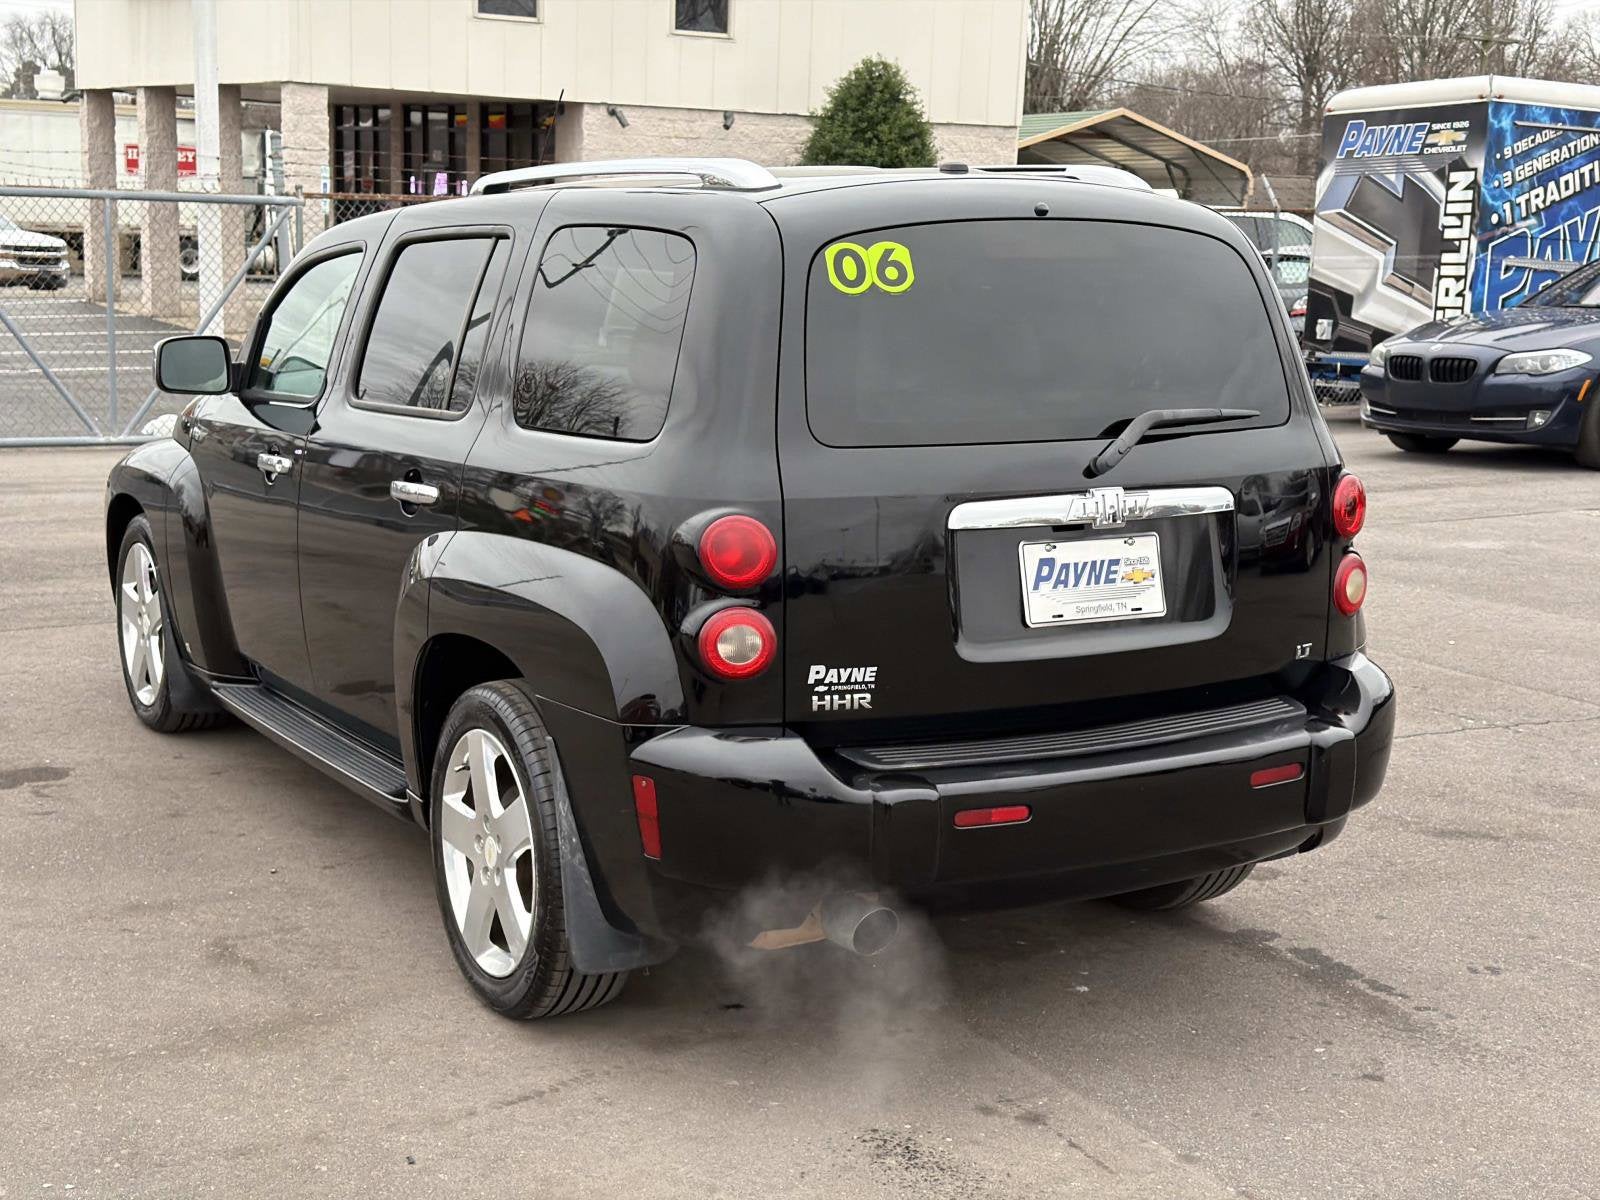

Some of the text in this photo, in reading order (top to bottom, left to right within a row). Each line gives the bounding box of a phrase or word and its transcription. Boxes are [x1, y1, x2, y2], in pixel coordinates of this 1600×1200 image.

[1431, 122, 1452, 131] SINCE
[1336, 120, 1430, 159] PAYNE
[1423, 144, 1467, 155] CHEVROLET
[1503, 146, 1512, 160] 9
[1503, 132, 1600, 188] 3 GENERATION
[1503, 201, 1513, 225] 1
[830, 245, 911, 291] 06
[1483, 205, 1600, 312] PAY
[1032, 557, 1121, 591] PAYNE
[807, 664, 878, 685] PAYNE
[811, 692, 873, 712] HHR
